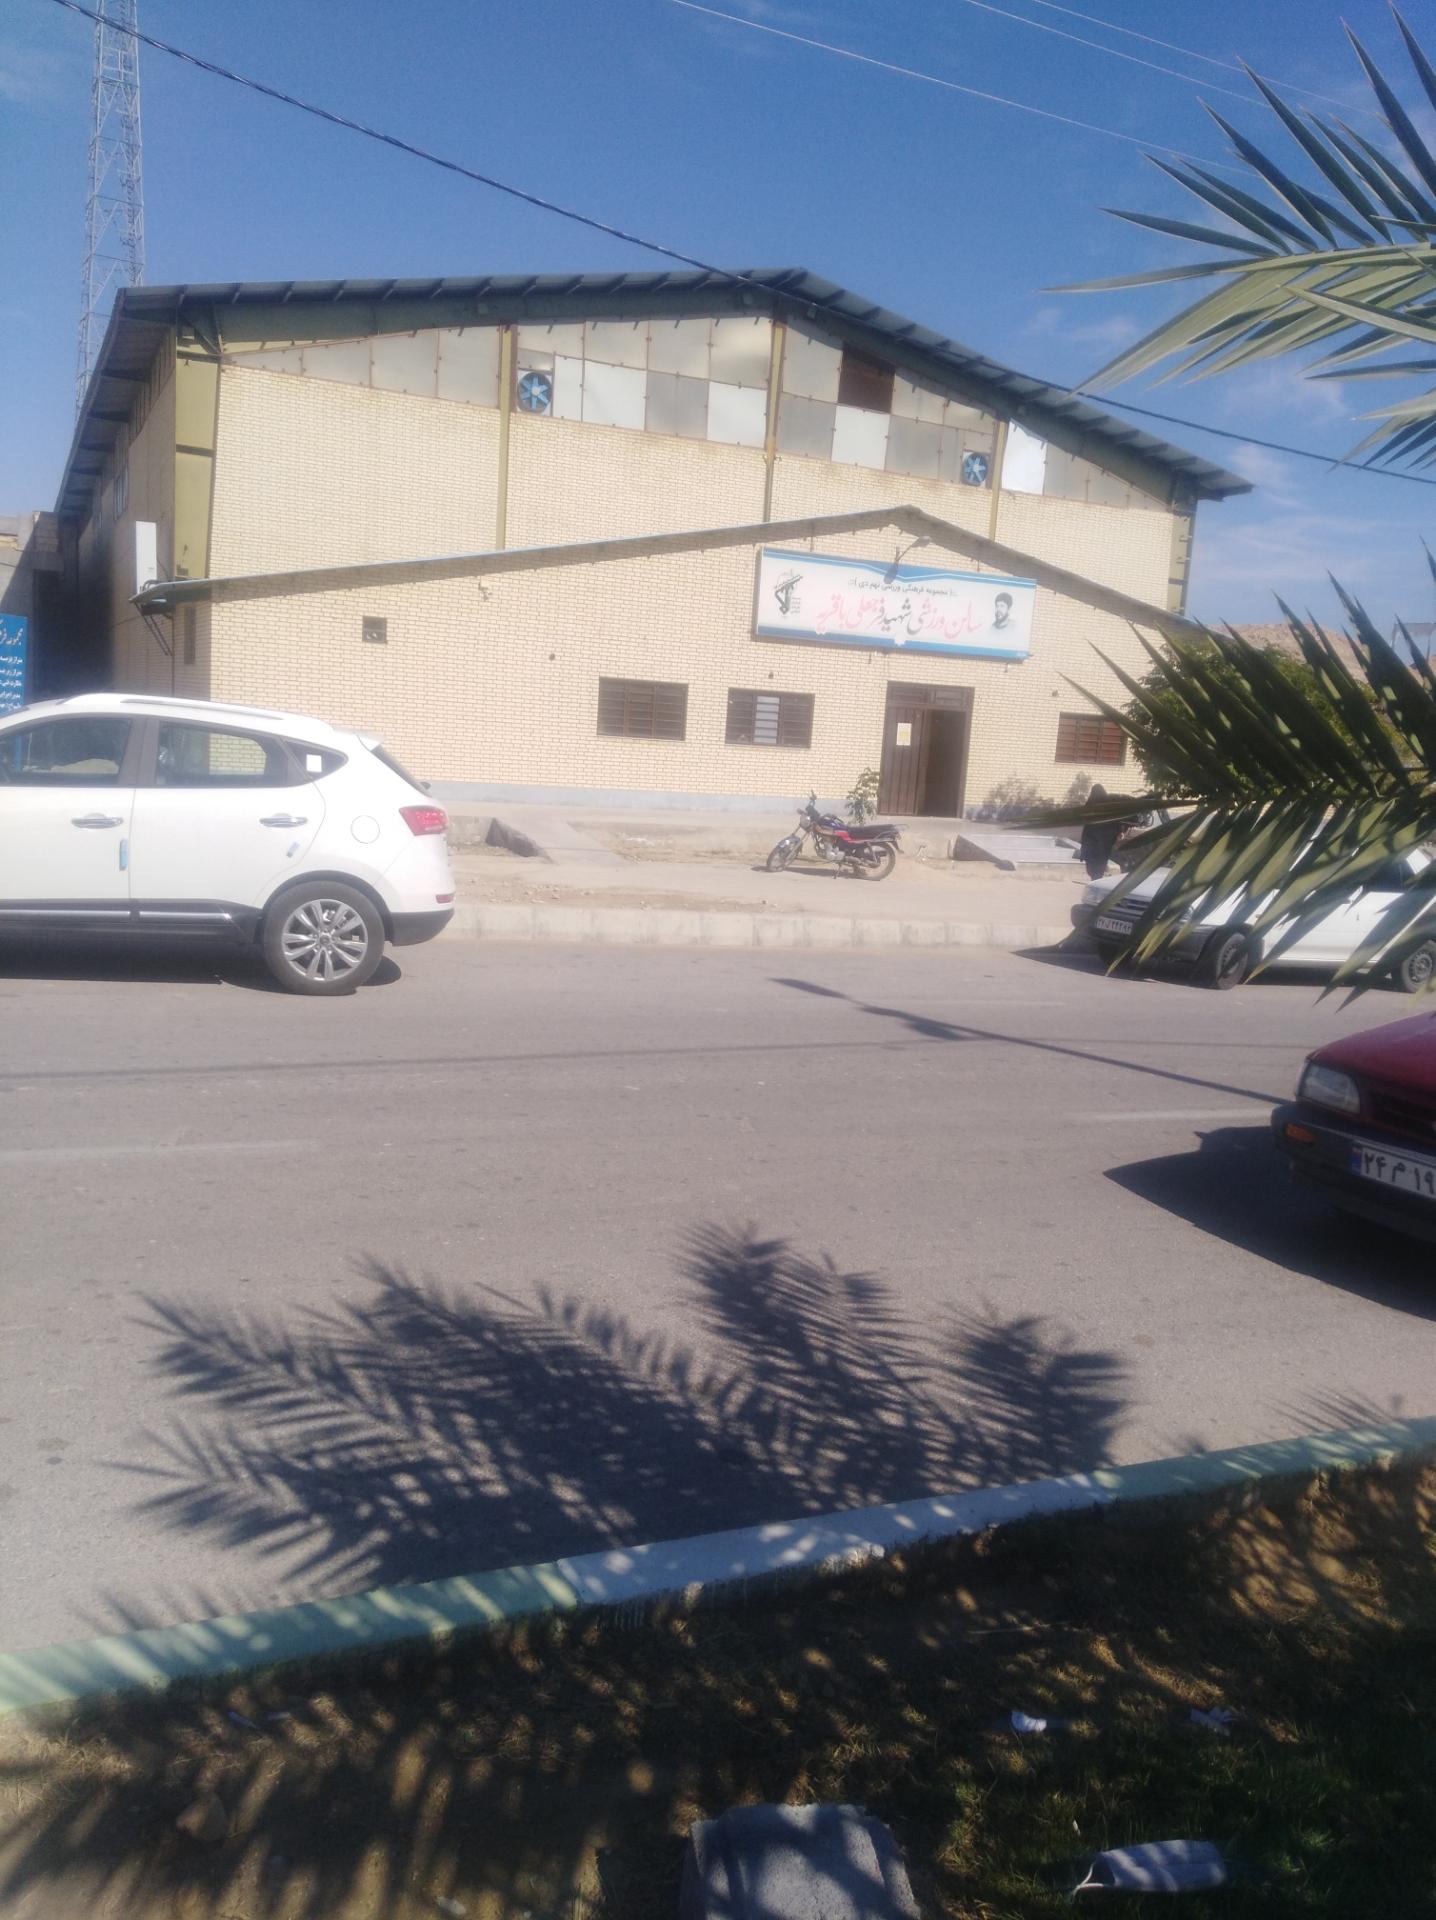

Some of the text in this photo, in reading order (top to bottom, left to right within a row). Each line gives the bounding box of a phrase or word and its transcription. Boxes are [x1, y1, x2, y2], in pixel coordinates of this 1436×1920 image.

[881, 597, 912, 633] شهید
[907, 597, 944, 636] ورزشی
[944, 600, 983, 640] سالن
